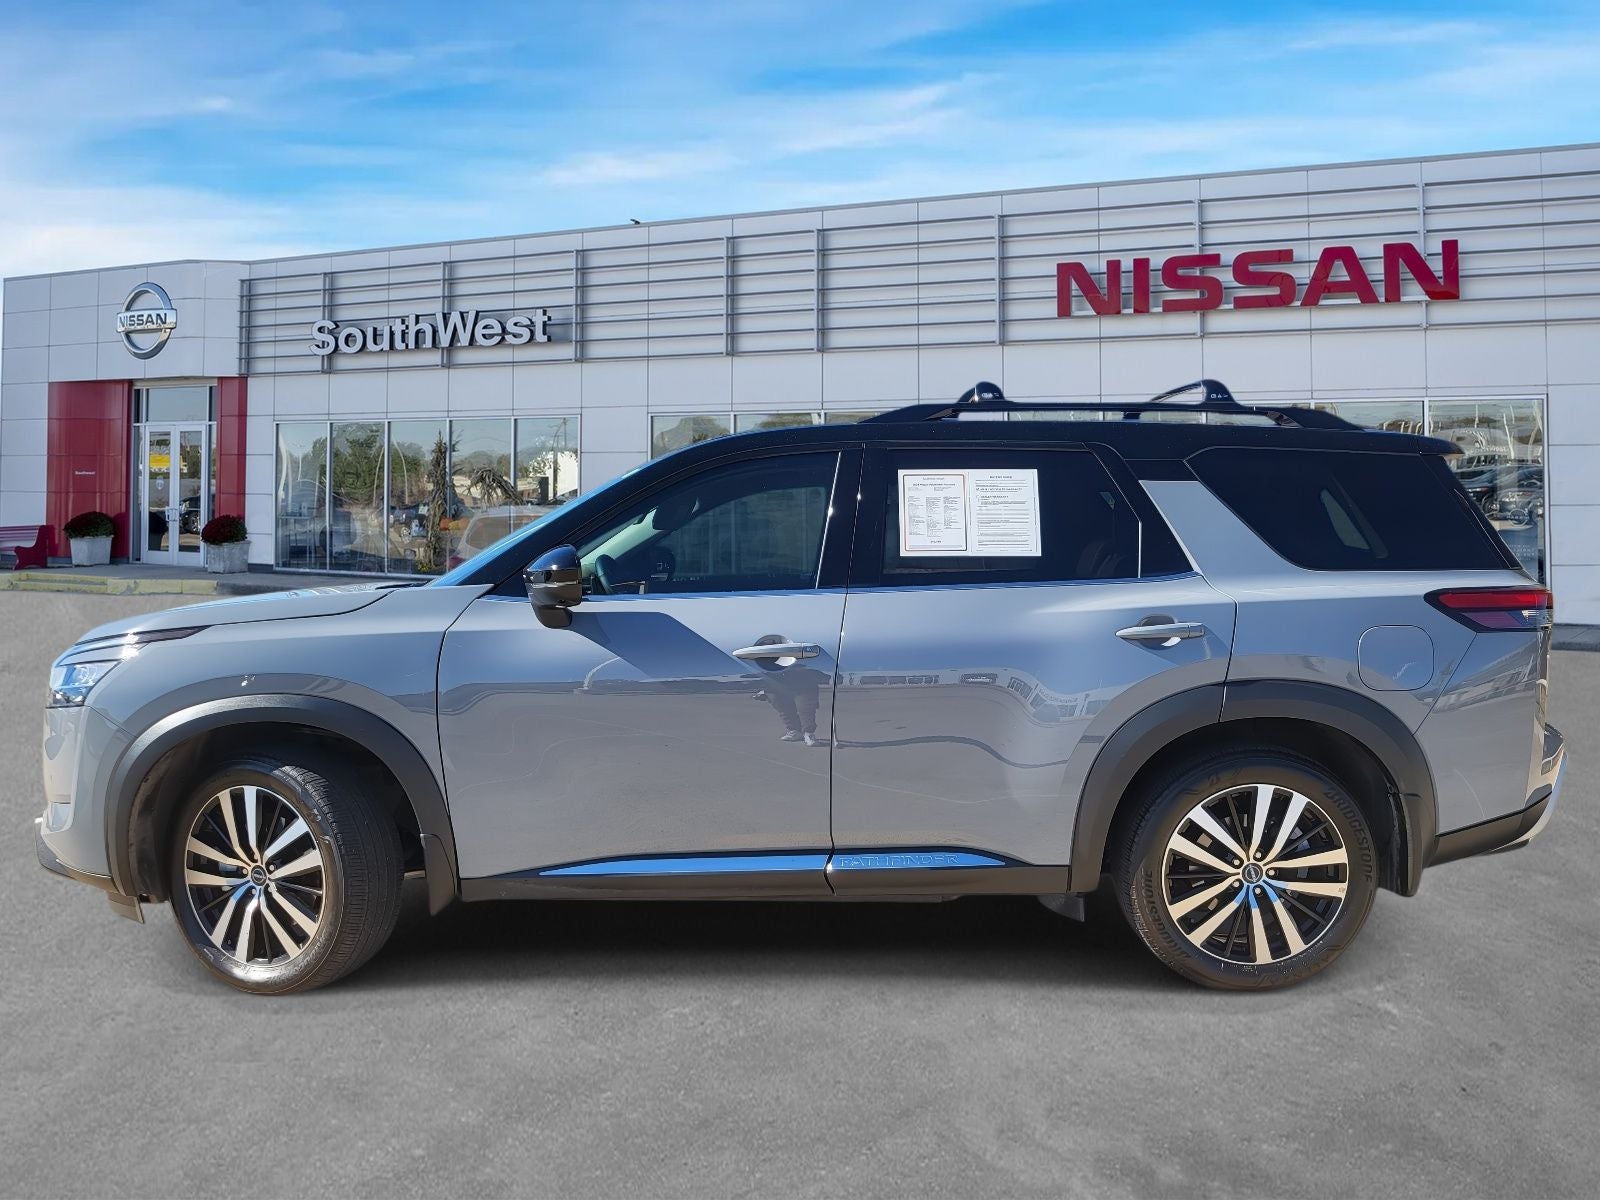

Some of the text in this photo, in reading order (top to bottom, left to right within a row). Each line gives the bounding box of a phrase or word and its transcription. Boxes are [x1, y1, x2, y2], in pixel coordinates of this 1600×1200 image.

[1056, 239, 1460, 318] NISSAN
[119, 312, 168, 329] NISSAN
[309, 308, 551, 356] SouthWest
[840, 853, 961, 868] PATHFINDER
